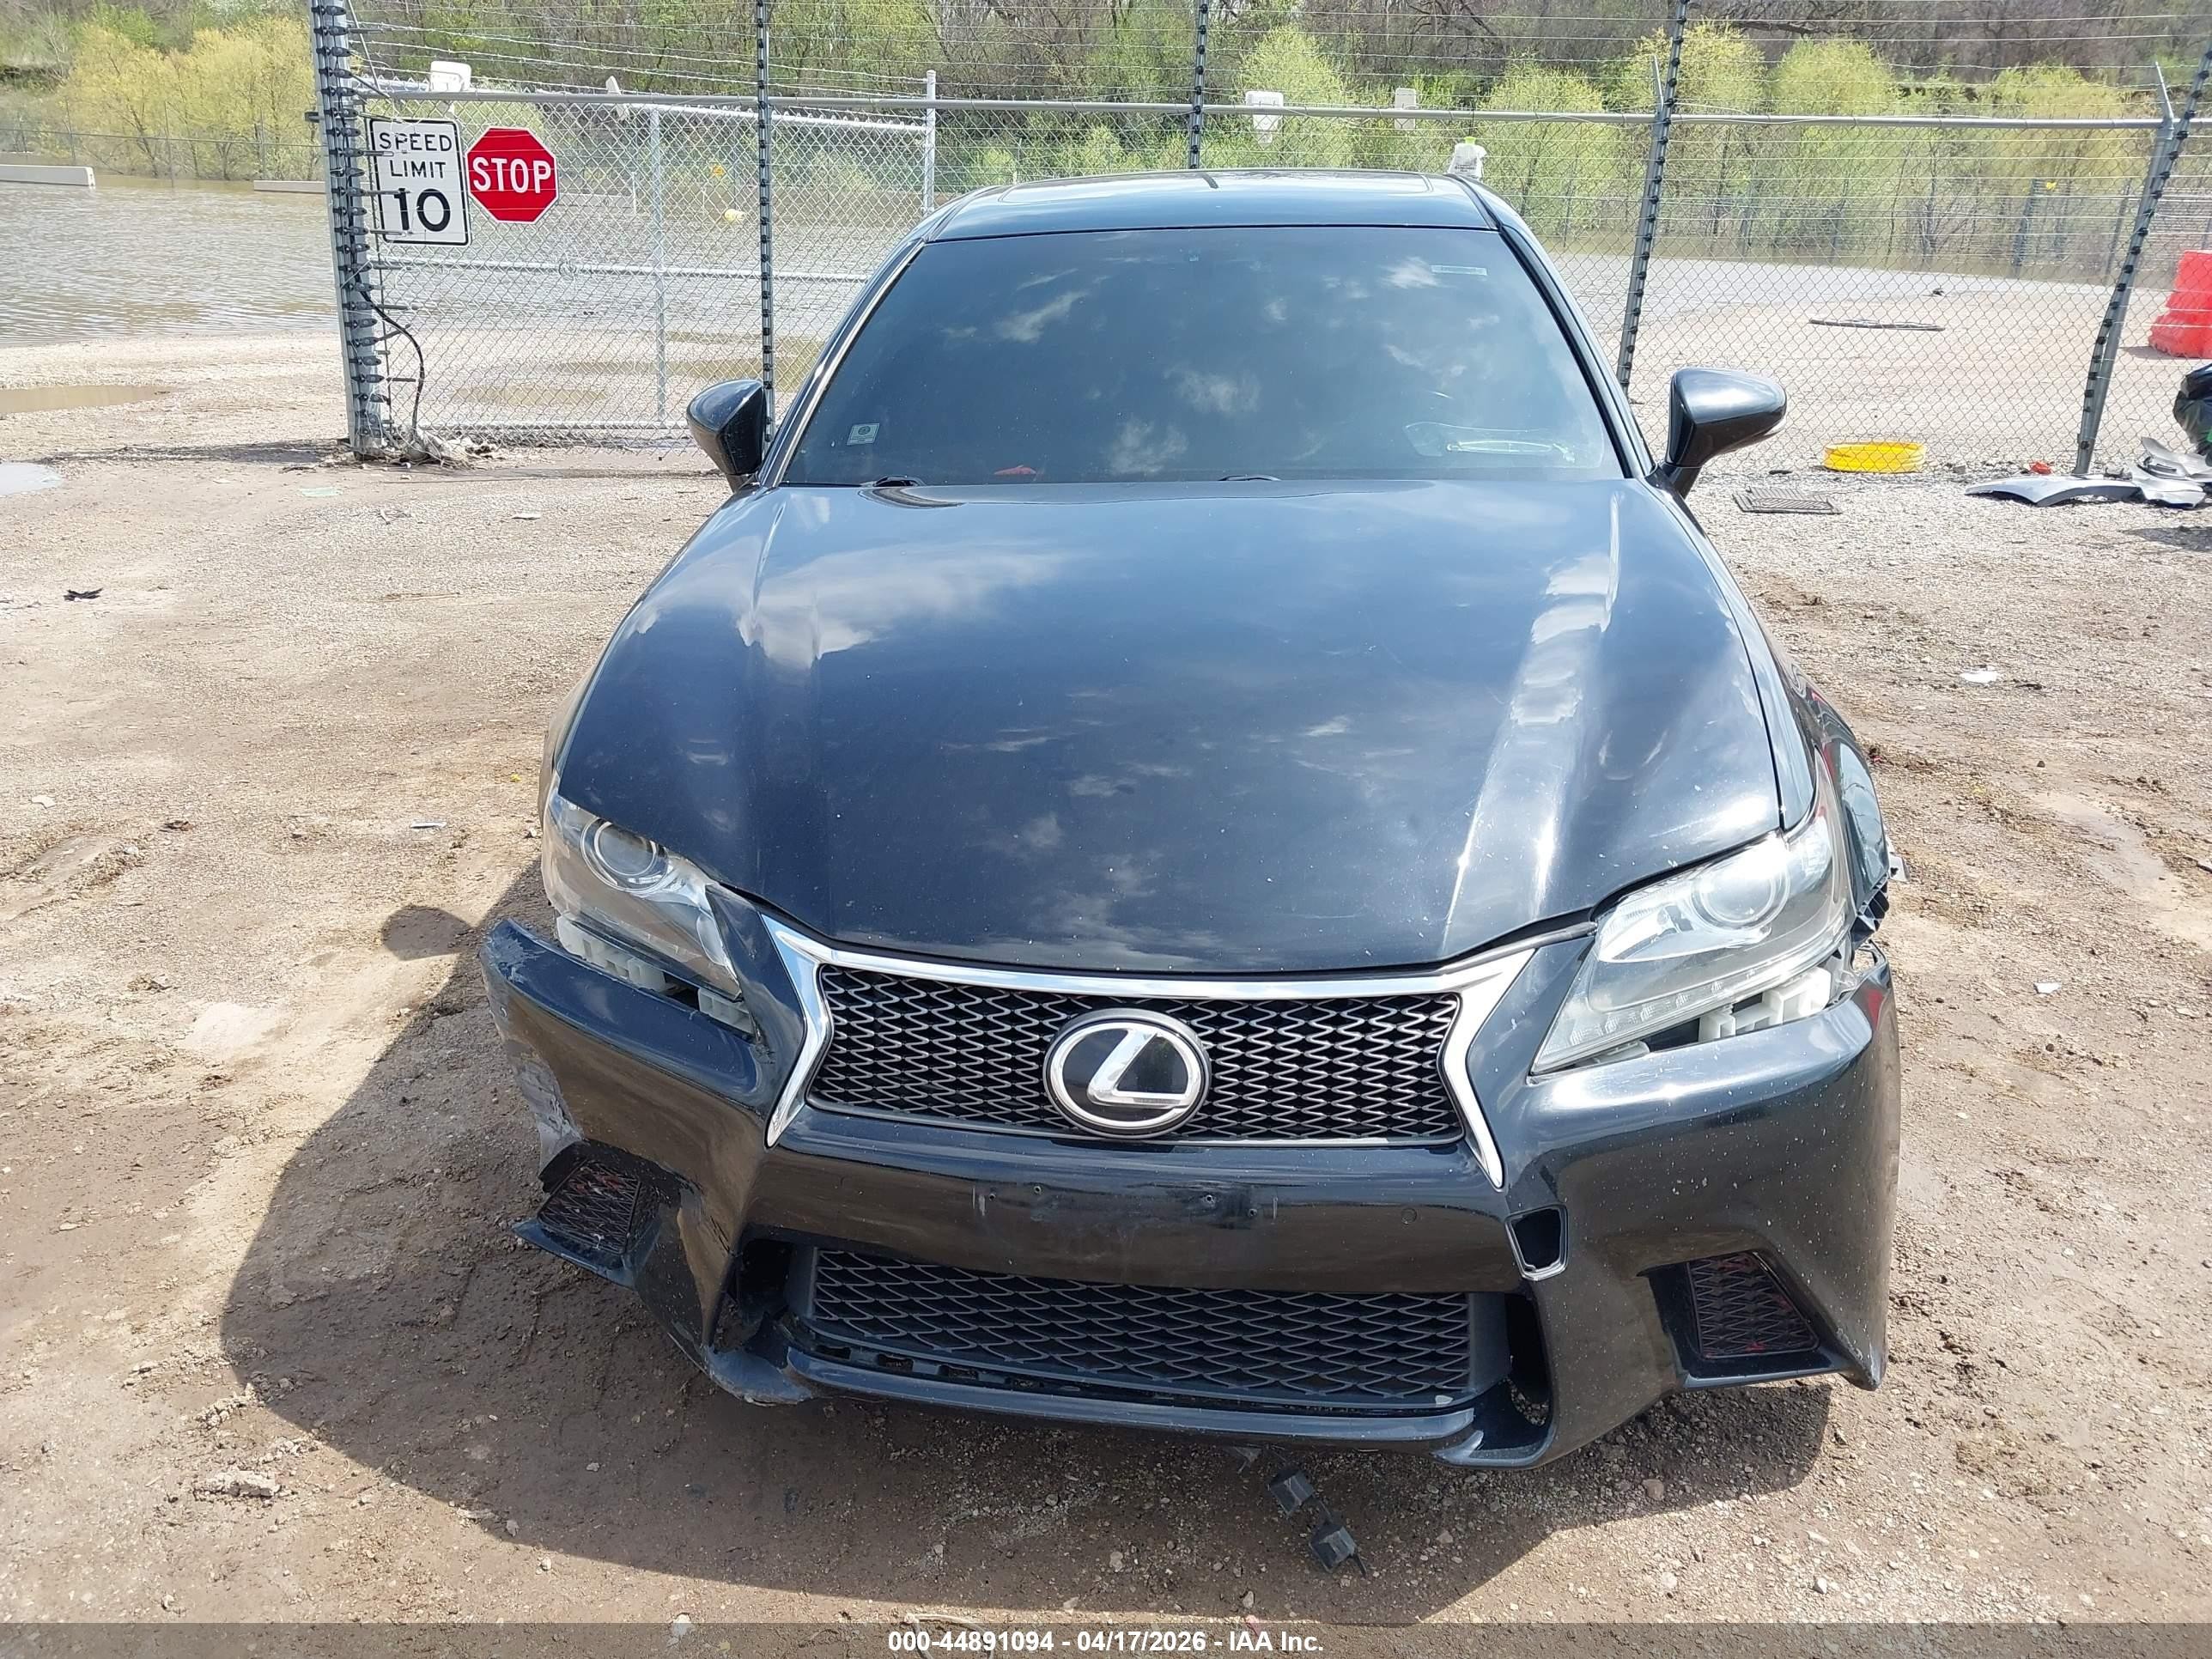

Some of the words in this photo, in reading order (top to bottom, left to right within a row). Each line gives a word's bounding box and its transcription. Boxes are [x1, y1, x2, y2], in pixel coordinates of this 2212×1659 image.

[379, 132, 453, 152] SPEED
[389, 161, 446, 179] LIMIT
[473, 157, 551, 193] STOP
[394, 188, 451, 232] 10
